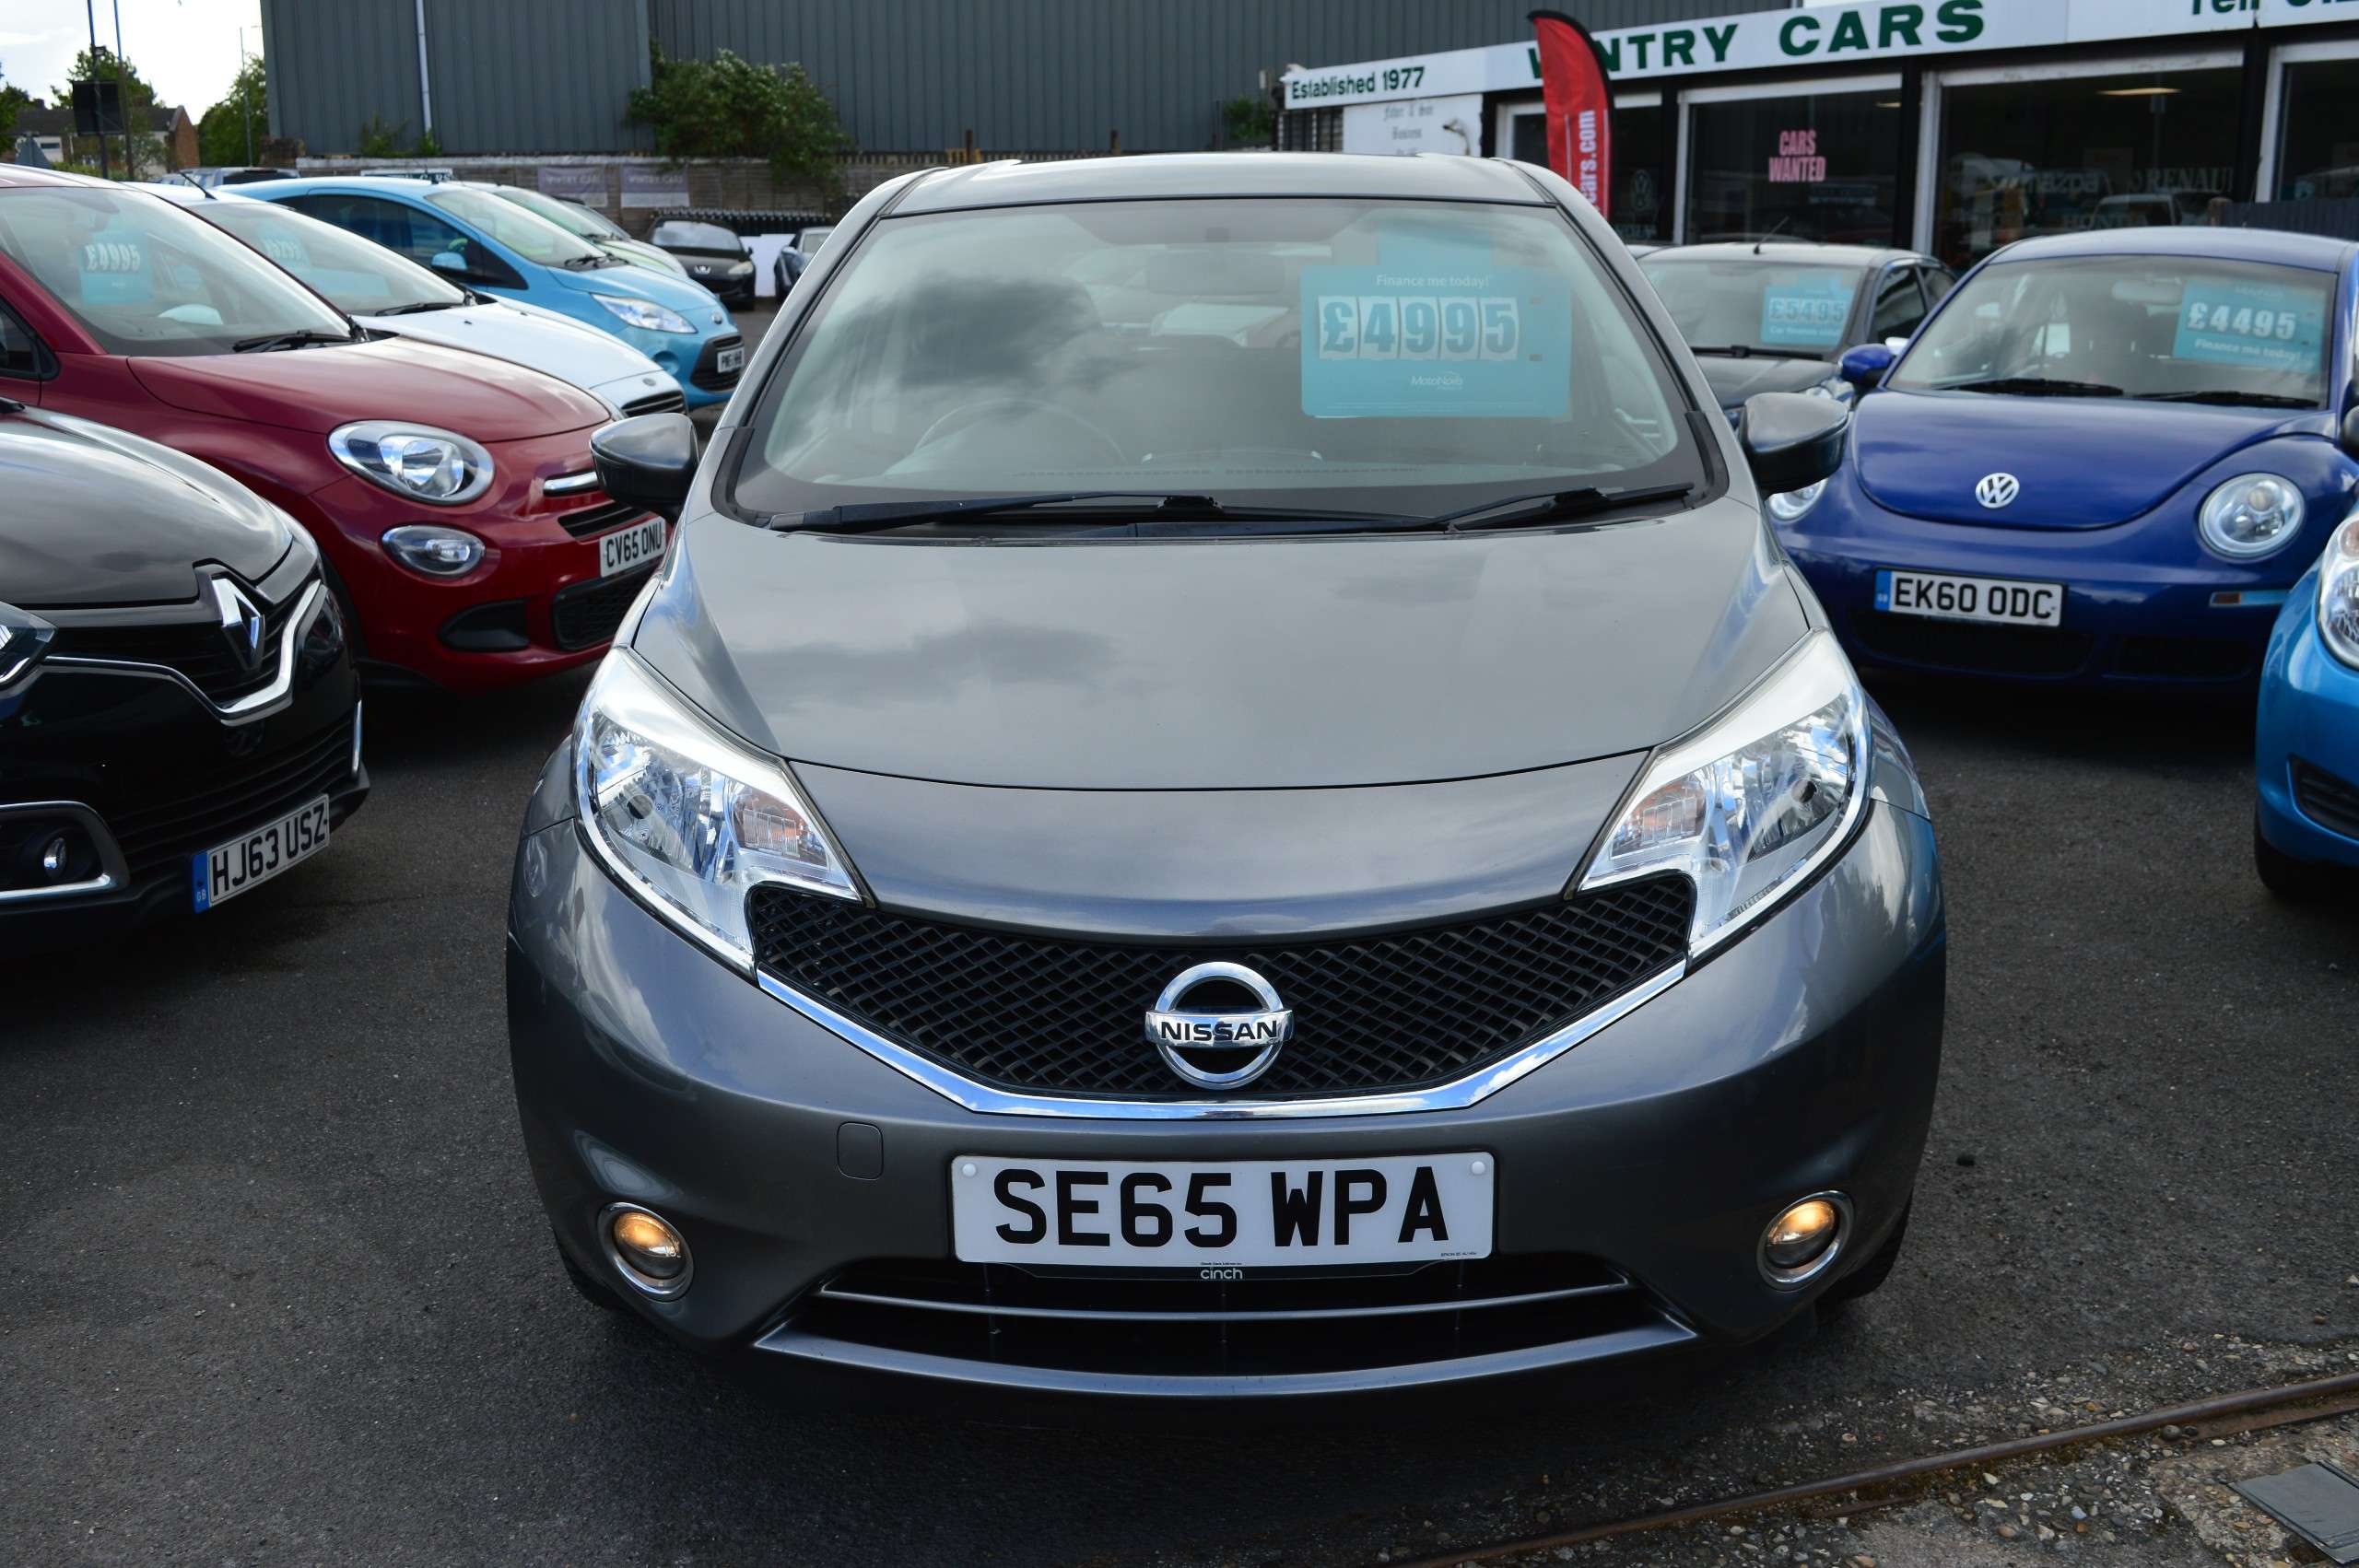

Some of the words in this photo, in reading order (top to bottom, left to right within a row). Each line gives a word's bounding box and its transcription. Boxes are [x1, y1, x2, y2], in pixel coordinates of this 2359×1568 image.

[1779, 0, 1985, 56] CARS
[1292, 72, 1376, 99] Established
[1383, 66, 1426, 90] 1977
[1779, 130, 1816, 156] CARS
[1769, 157, 1826, 182] WANTED
[1377, 275, 1425, 287] Finance
[1428, 278, 1447, 287] me
[1449, 275, 1488, 289] today!
[1770, 300, 1845, 322] £5495
[2188, 301, 2296, 340] £4495
[1322, 301, 1517, 354] £4995
[2195, 338, 2240, 354] Finance
[2242, 346, 2260, 355] me
[2263, 346, 2301, 361] today!
[606, 529, 639, 568] CV65
[641, 521, 663, 556] ONU
[1895, 577, 1978, 613] EK60
[1988, 586, 2053, 620] ODC
[212, 828, 280, 897] HJ63
[286, 802, 326, 860] USZ
[196, 888, 207, 903] GB
[1161, 1019, 1277, 1043] NISSAN
[993, 1168, 1238, 1248] SE65
[1271, 1165, 1449, 1247] WPA
[1200, 1267, 1243, 1280] cinch
